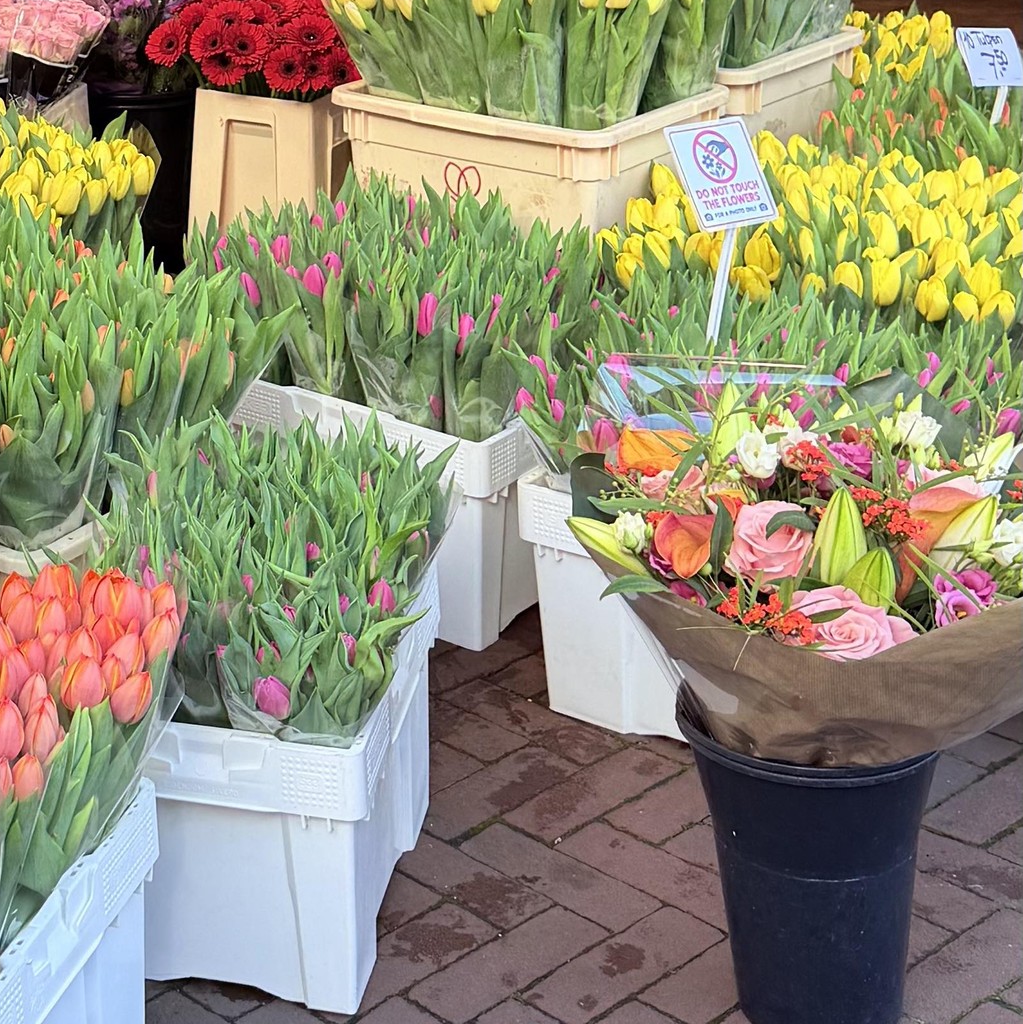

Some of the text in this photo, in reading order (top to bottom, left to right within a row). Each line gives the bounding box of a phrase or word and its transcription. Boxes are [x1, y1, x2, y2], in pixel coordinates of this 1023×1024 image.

[962, 32, 975, 50] 10
[695, 180, 760, 201] DO NOT TOUCH
[702, 192, 761, 212] THE FLOWERS
[729, 208, 745, 217] PHOTO
[745, 206, 758, 215] ONLY
